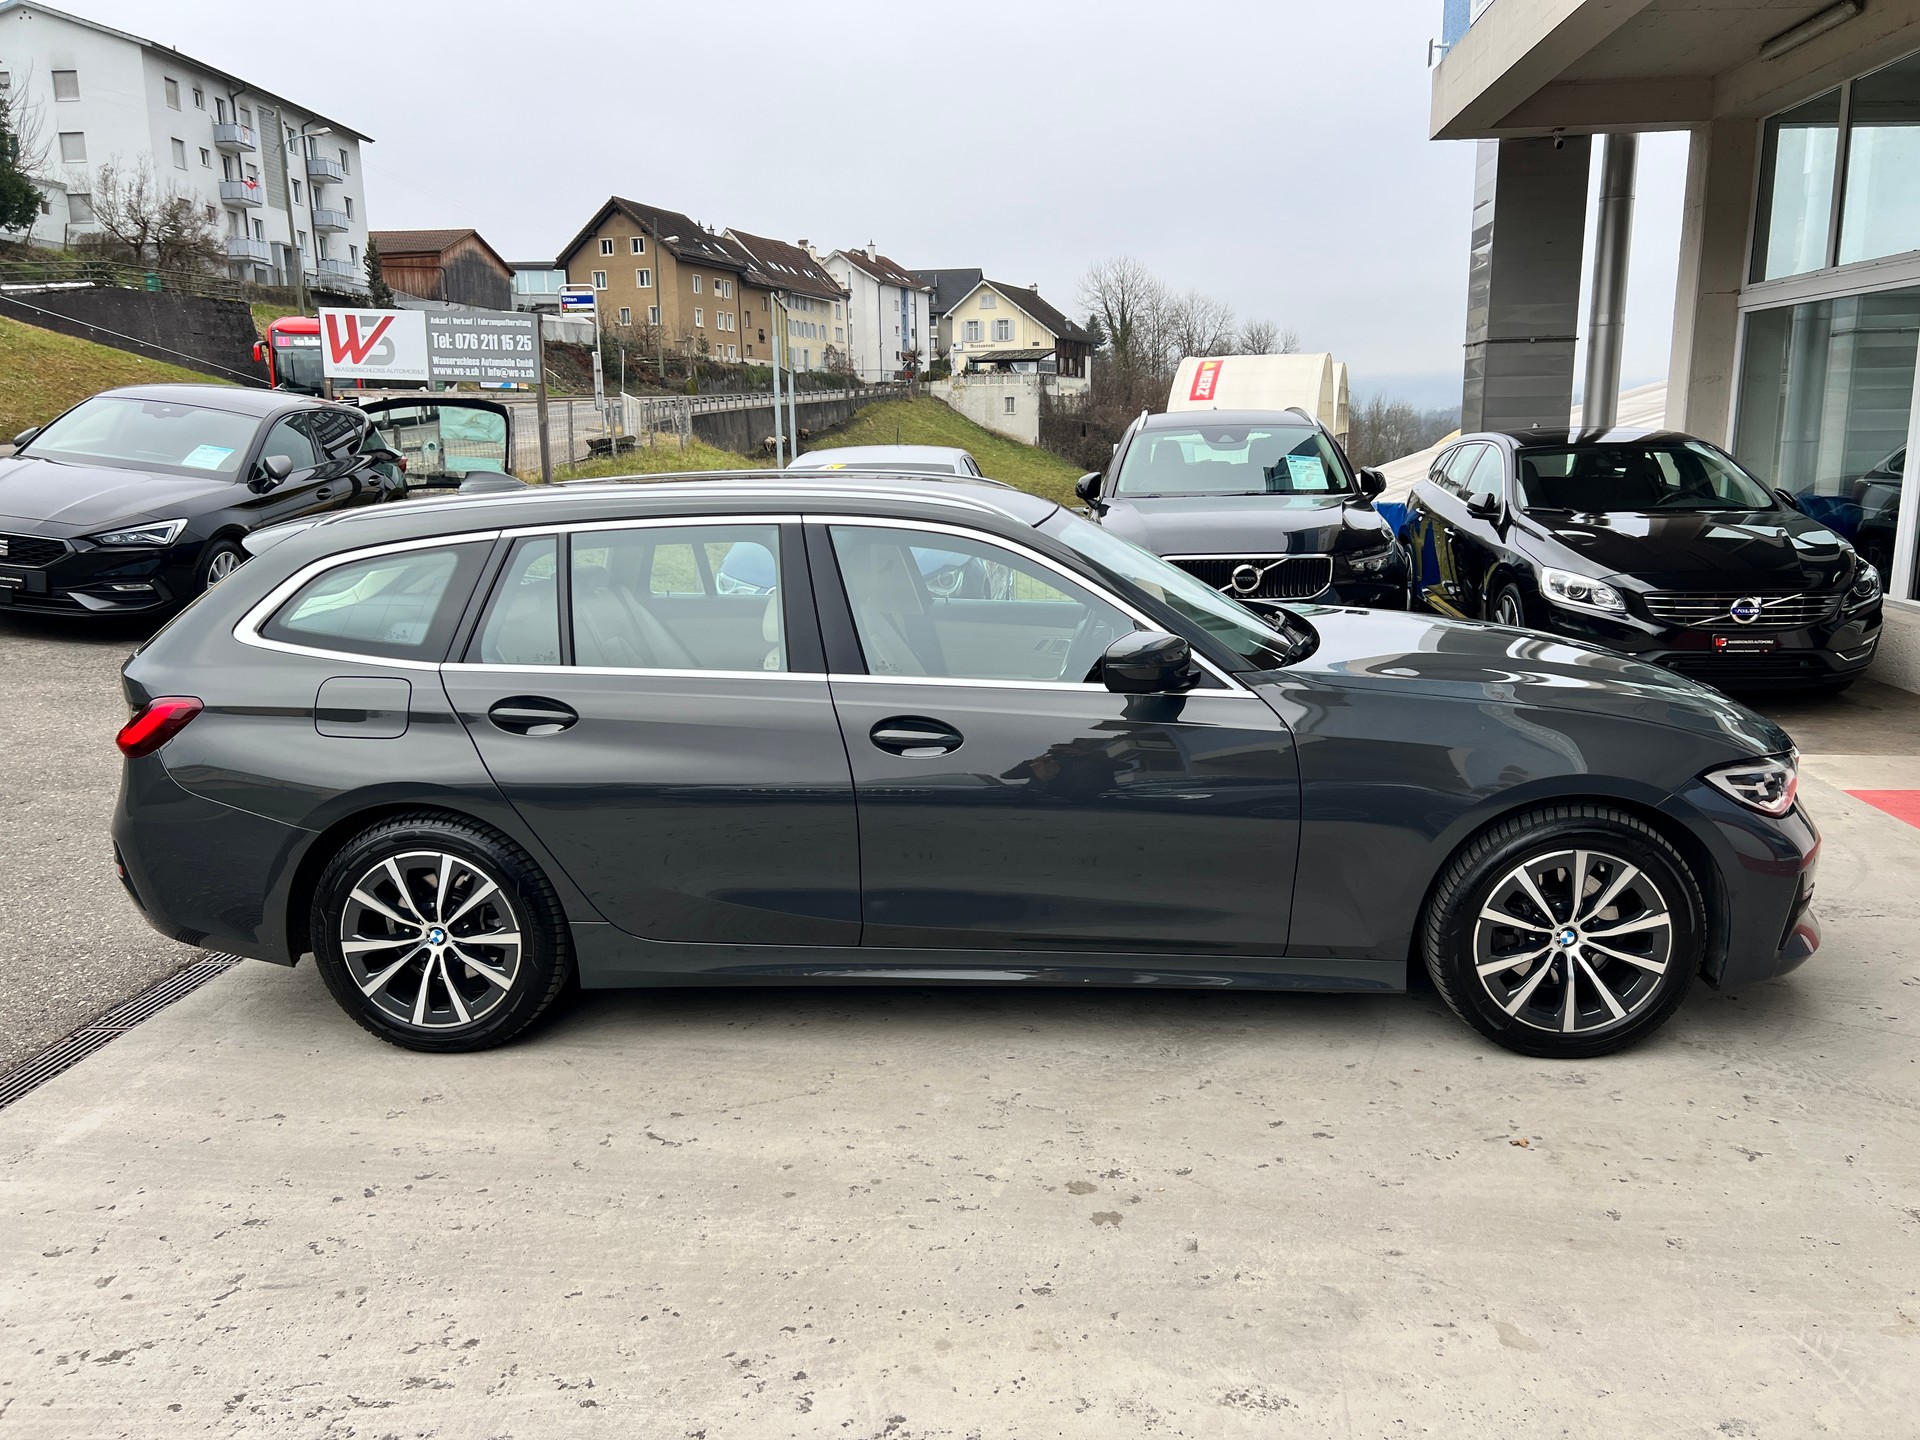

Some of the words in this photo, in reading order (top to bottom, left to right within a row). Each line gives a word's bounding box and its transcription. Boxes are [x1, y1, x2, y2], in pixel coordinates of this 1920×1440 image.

[455, 333, 478, 349] 076
[480, 334, 499, 350] 211
[501, 334, 514, 350] 15
[516, 335, 532, 351] 25
[432, 356, 480, 366] Wasserschloss
[481, 358, 515, 367] Automobile
[516, 359, 534, 368] GmbH
[433, 367, 479, 376] www.ws-a.ch
[1195, 370, 1215, 398] MERZ
